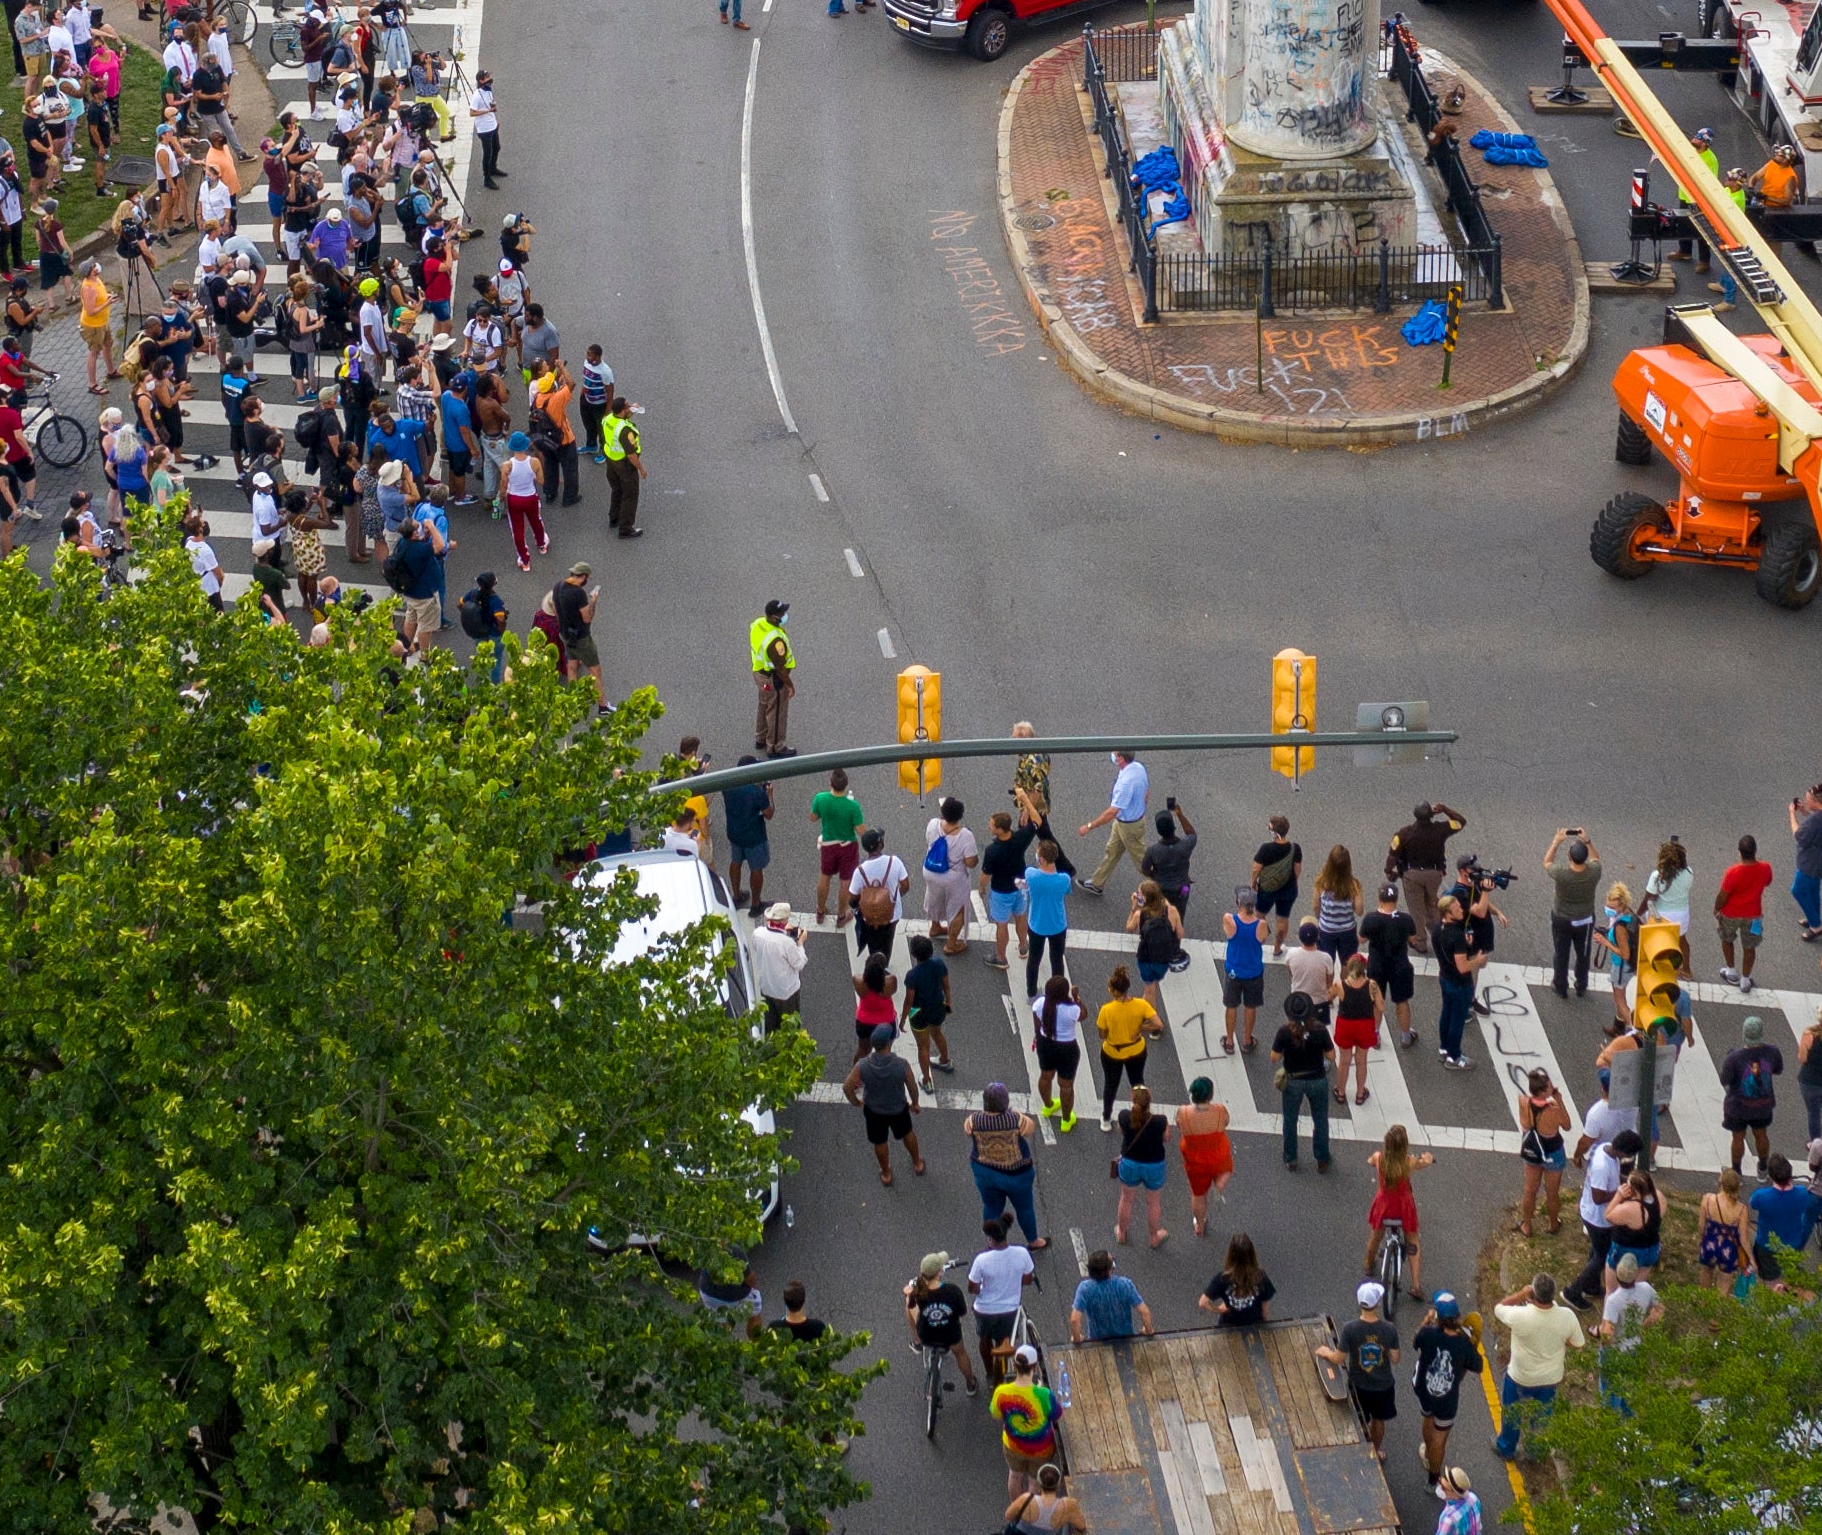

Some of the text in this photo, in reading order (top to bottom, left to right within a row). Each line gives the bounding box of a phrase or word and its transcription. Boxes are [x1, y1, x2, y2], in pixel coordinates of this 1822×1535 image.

[935, 246, 1026, 358] AMERIKKKA
[1263, 326, 1381, 354] FUCK
[1283, 347, 1398, 372] THIS
[1167, 357, 1313, 393] FUCK
[1417, 412, 1470, 441] BLM
